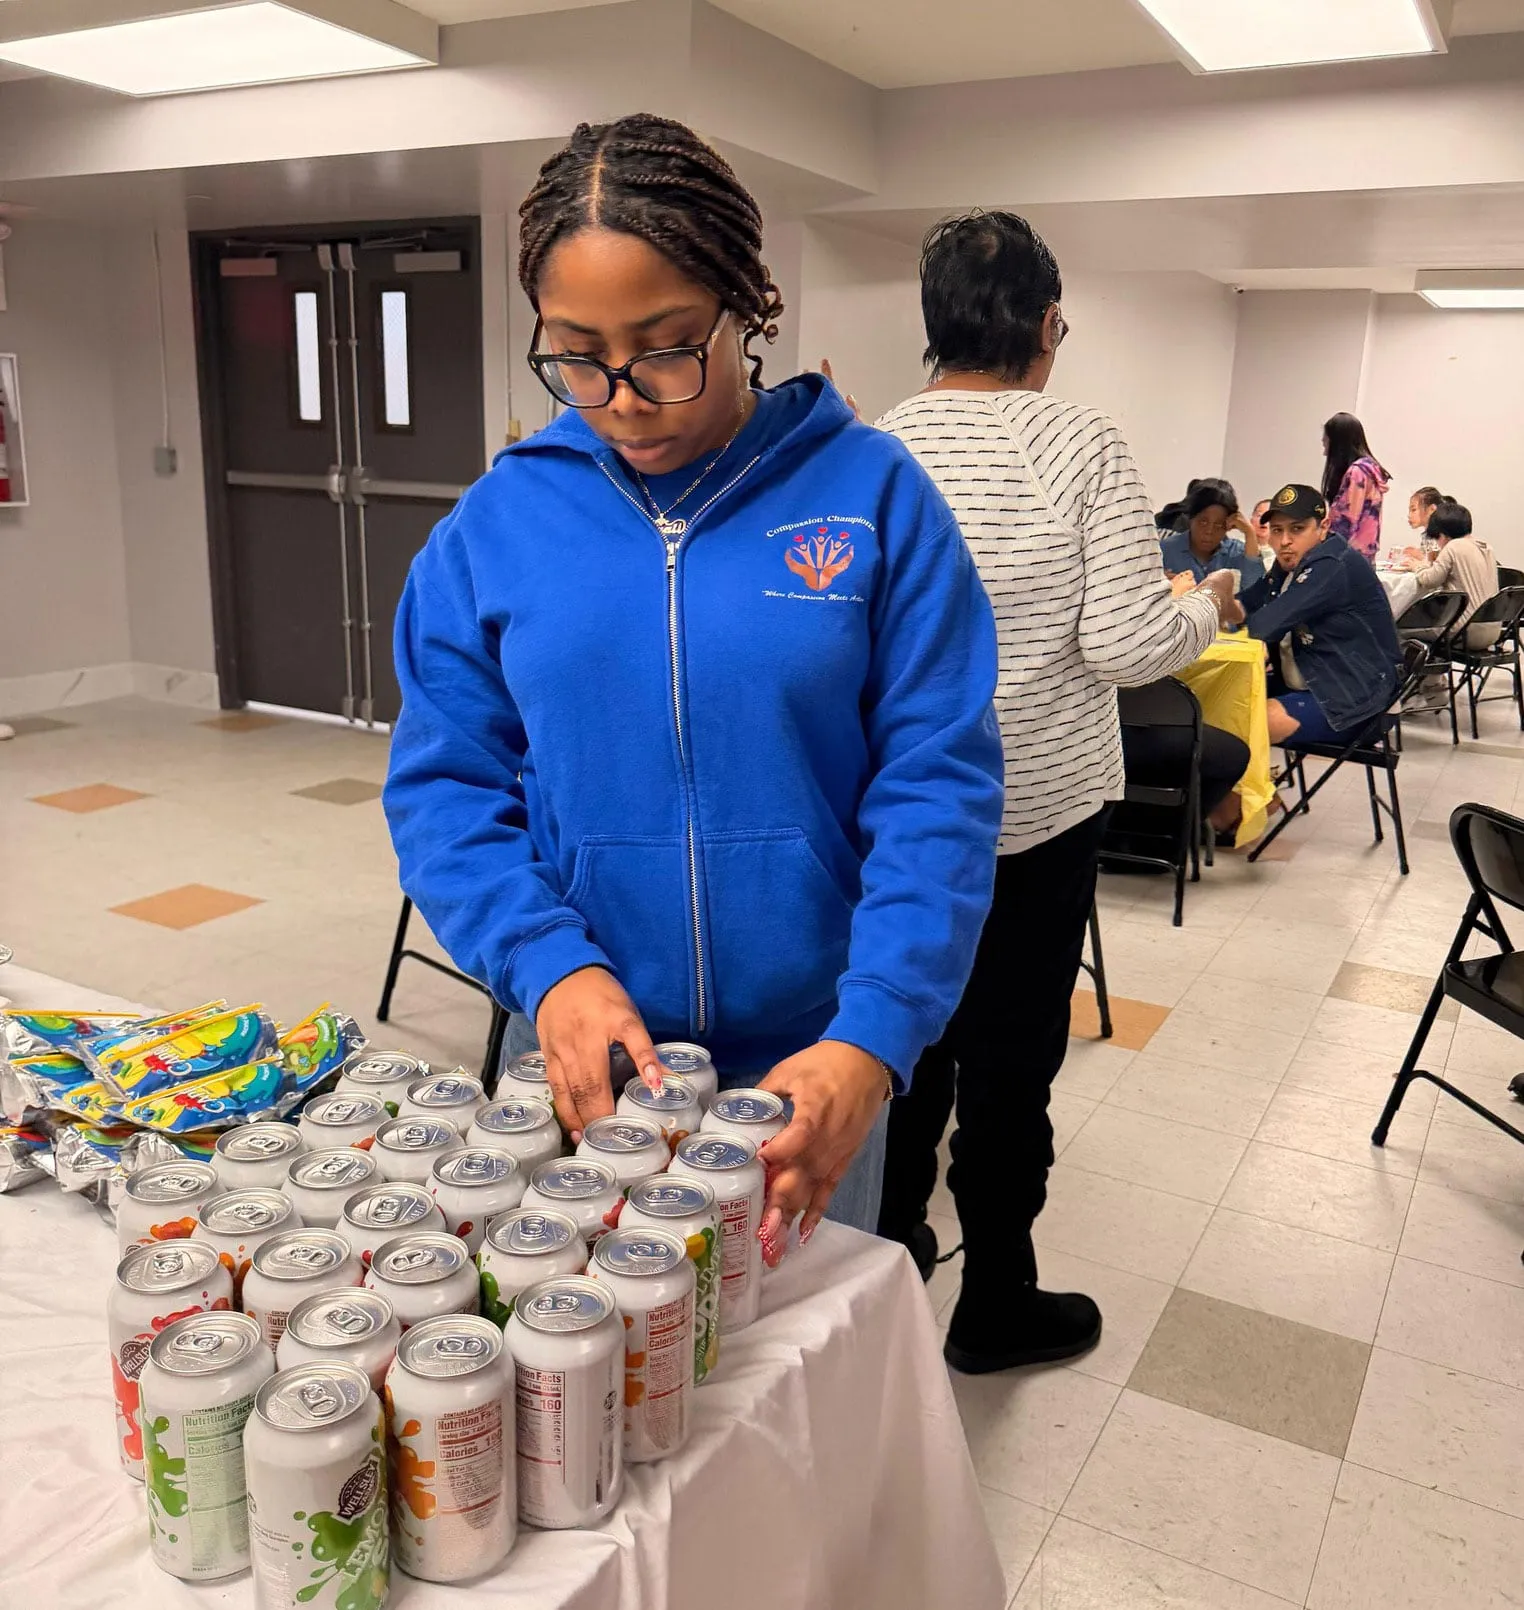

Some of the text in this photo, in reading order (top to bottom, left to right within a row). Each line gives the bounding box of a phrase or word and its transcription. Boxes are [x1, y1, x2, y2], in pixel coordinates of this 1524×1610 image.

[766, 515, 876, 538] Compassion Champions
[153, 1043, 193, 1077] CAPR
[267, 1316, 287, 1327] Nutri
[536, 1371, 561, 1384] Facts
[541, 1400, 562, 1411] 160
[185, 1412, 230, 1427] Nutrition
[438, 1415, 480, 1431] Nutrition
[440, 1445, 479, 1459] Calories
[341, 1463, 376, 1516] WELLSLEY
